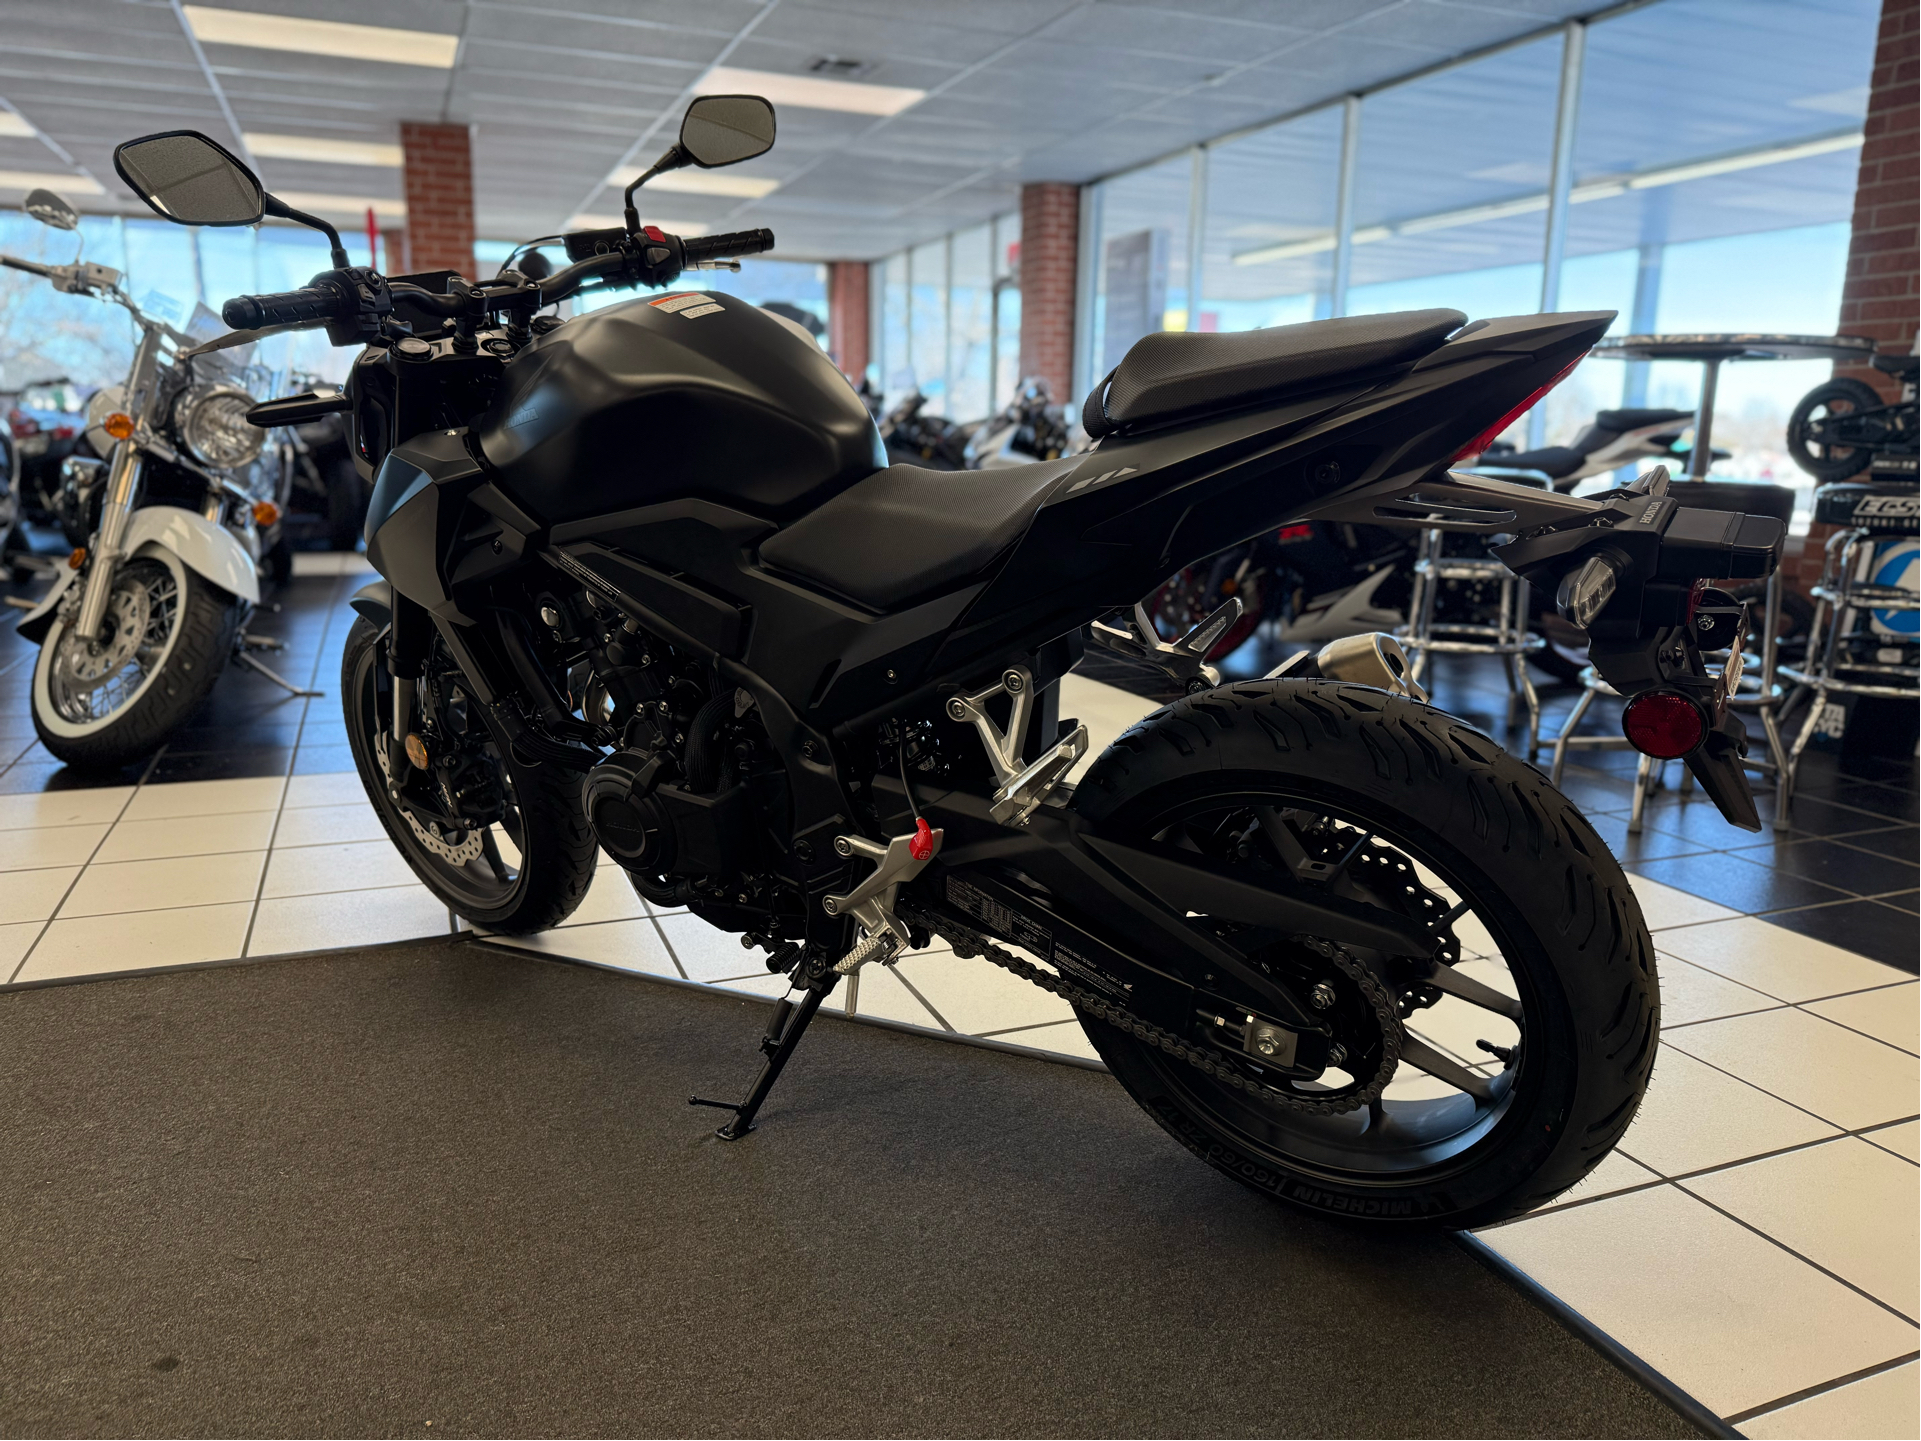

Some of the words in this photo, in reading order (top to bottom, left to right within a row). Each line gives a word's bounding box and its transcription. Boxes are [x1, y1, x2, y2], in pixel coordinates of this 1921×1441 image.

[1639, 501, 1663, 524] HONDA
[1178, 1122, 1208, 1144] ZR
[1208, 1143, 1277, 1188] 160/60
[1293, 1186, 1412, 1216] MICHELIN
